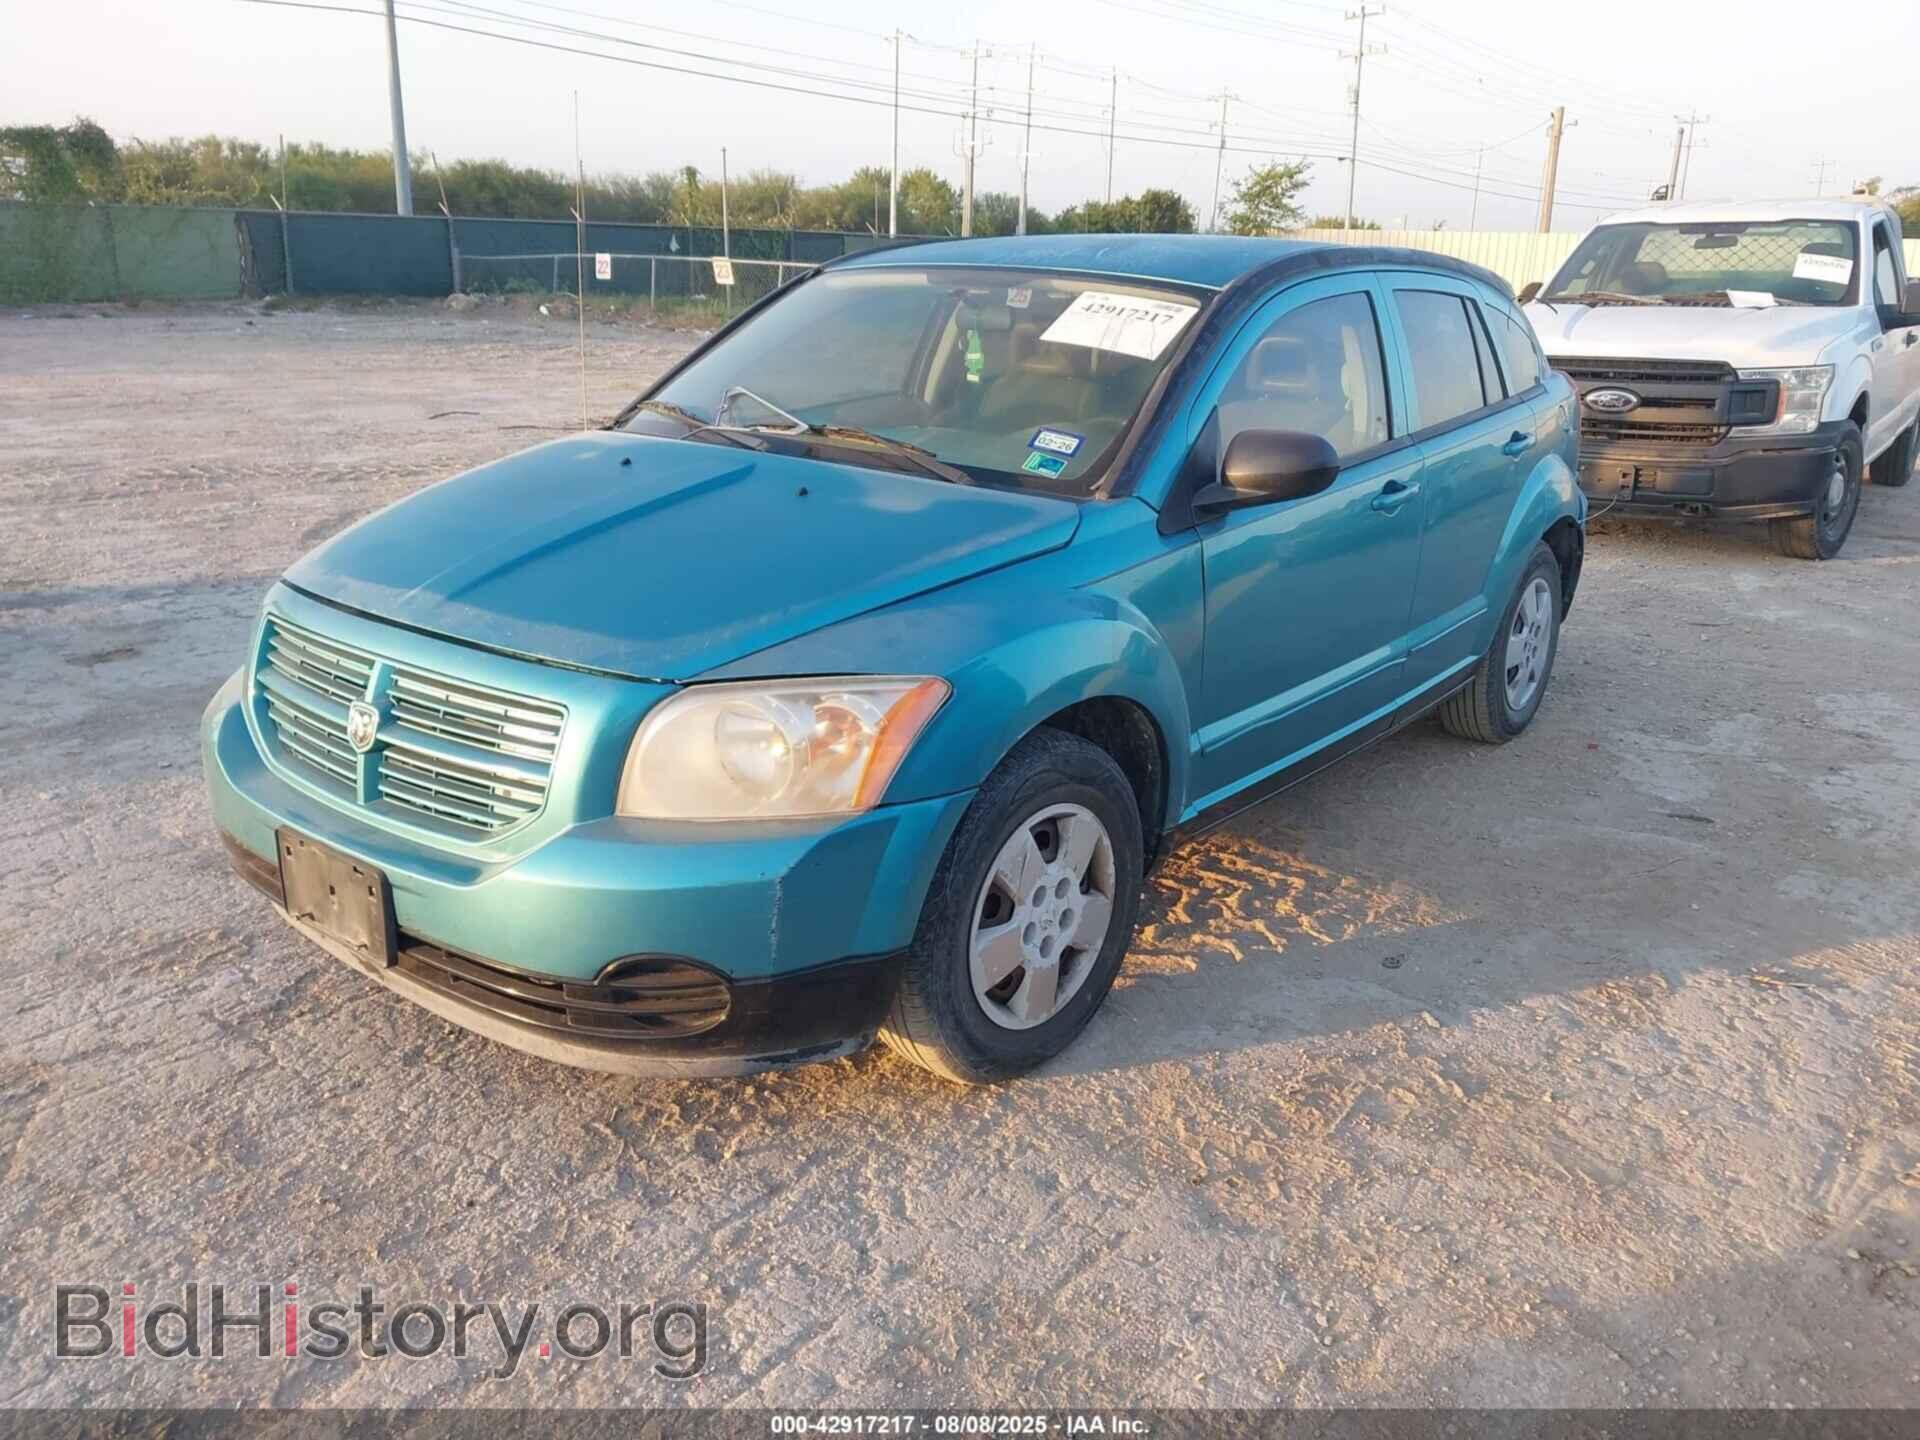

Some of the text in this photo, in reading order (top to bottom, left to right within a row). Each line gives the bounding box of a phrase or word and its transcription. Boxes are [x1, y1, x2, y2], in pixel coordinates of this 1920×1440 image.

[597, 260, 609, 274] 22
[1081, 303, 1174, 325] 42917217
[1038, 437, 1074, 451] 02-26
